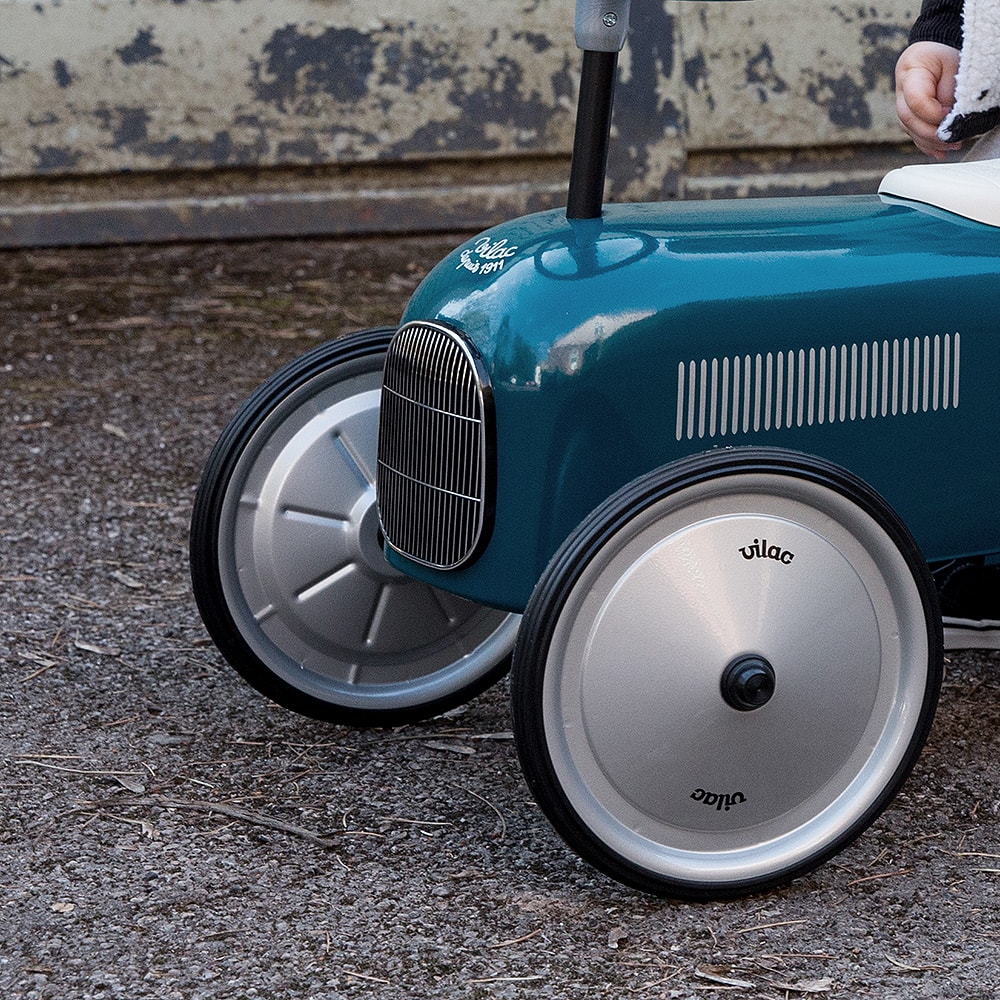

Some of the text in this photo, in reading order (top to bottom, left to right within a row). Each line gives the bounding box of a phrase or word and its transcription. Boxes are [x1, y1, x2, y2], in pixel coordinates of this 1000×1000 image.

[478, 259, 505, 275] 1911
[738, 538, 794, 565] vilac
[689, 788, 747, 811] vilac
